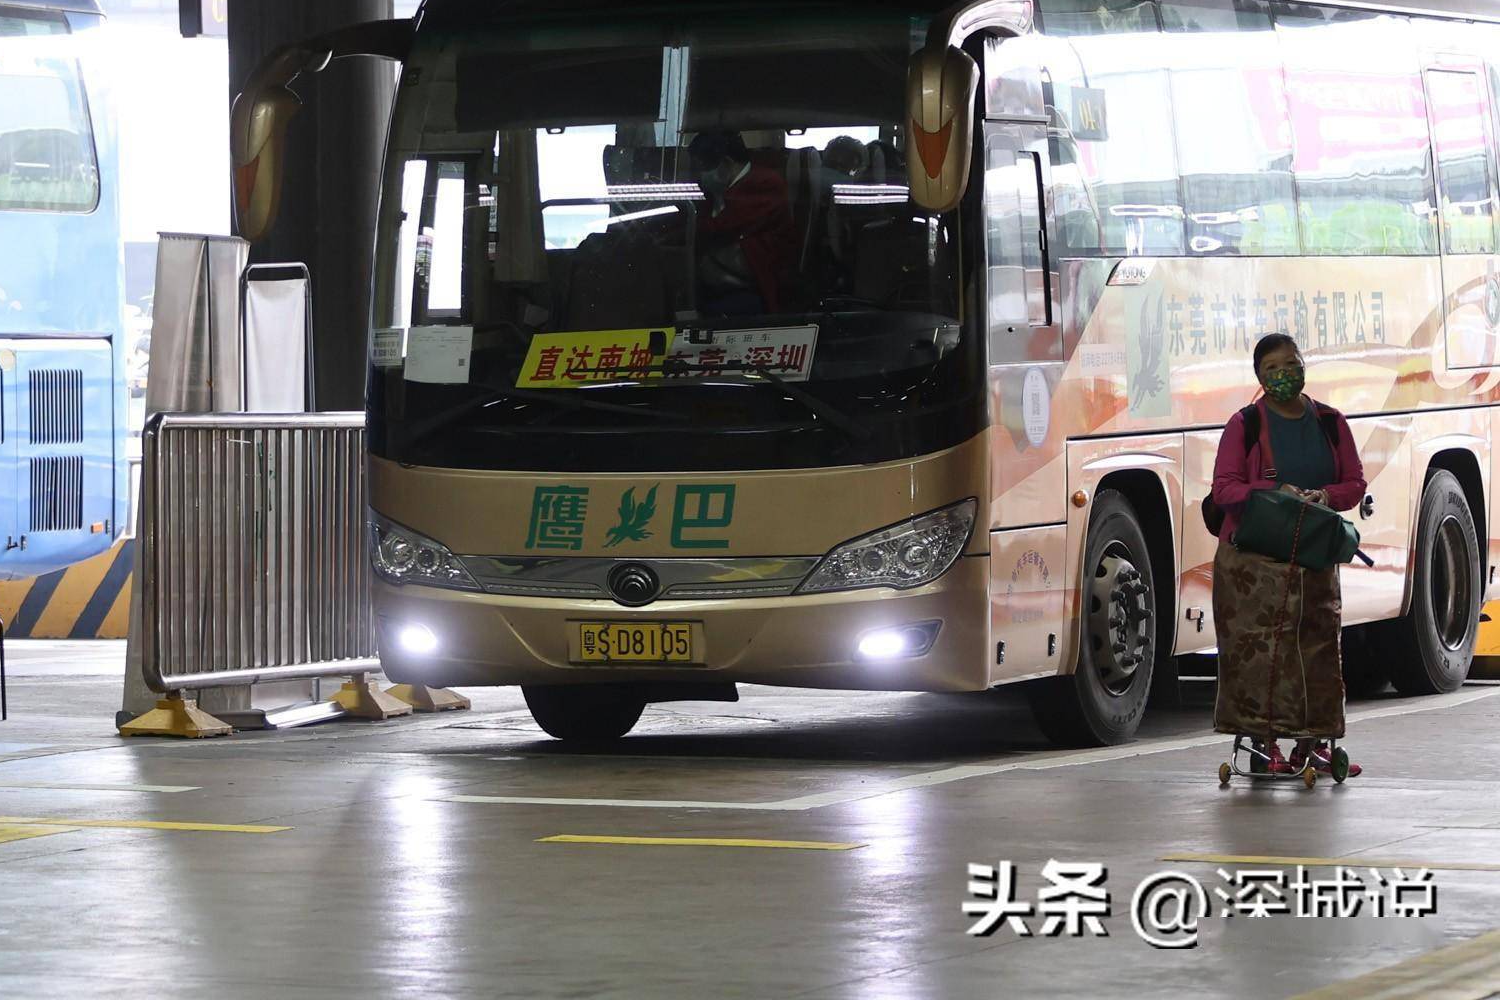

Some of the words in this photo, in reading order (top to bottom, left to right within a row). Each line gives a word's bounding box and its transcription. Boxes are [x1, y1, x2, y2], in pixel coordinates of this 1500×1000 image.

[1166, 290, 1386, 356] 东莞市汽车运输有限公司
[529, 342, 654, 383] 直达南城
[524, 485, 590, 550] 鹰
[670, 484, 736, 549] 巴
